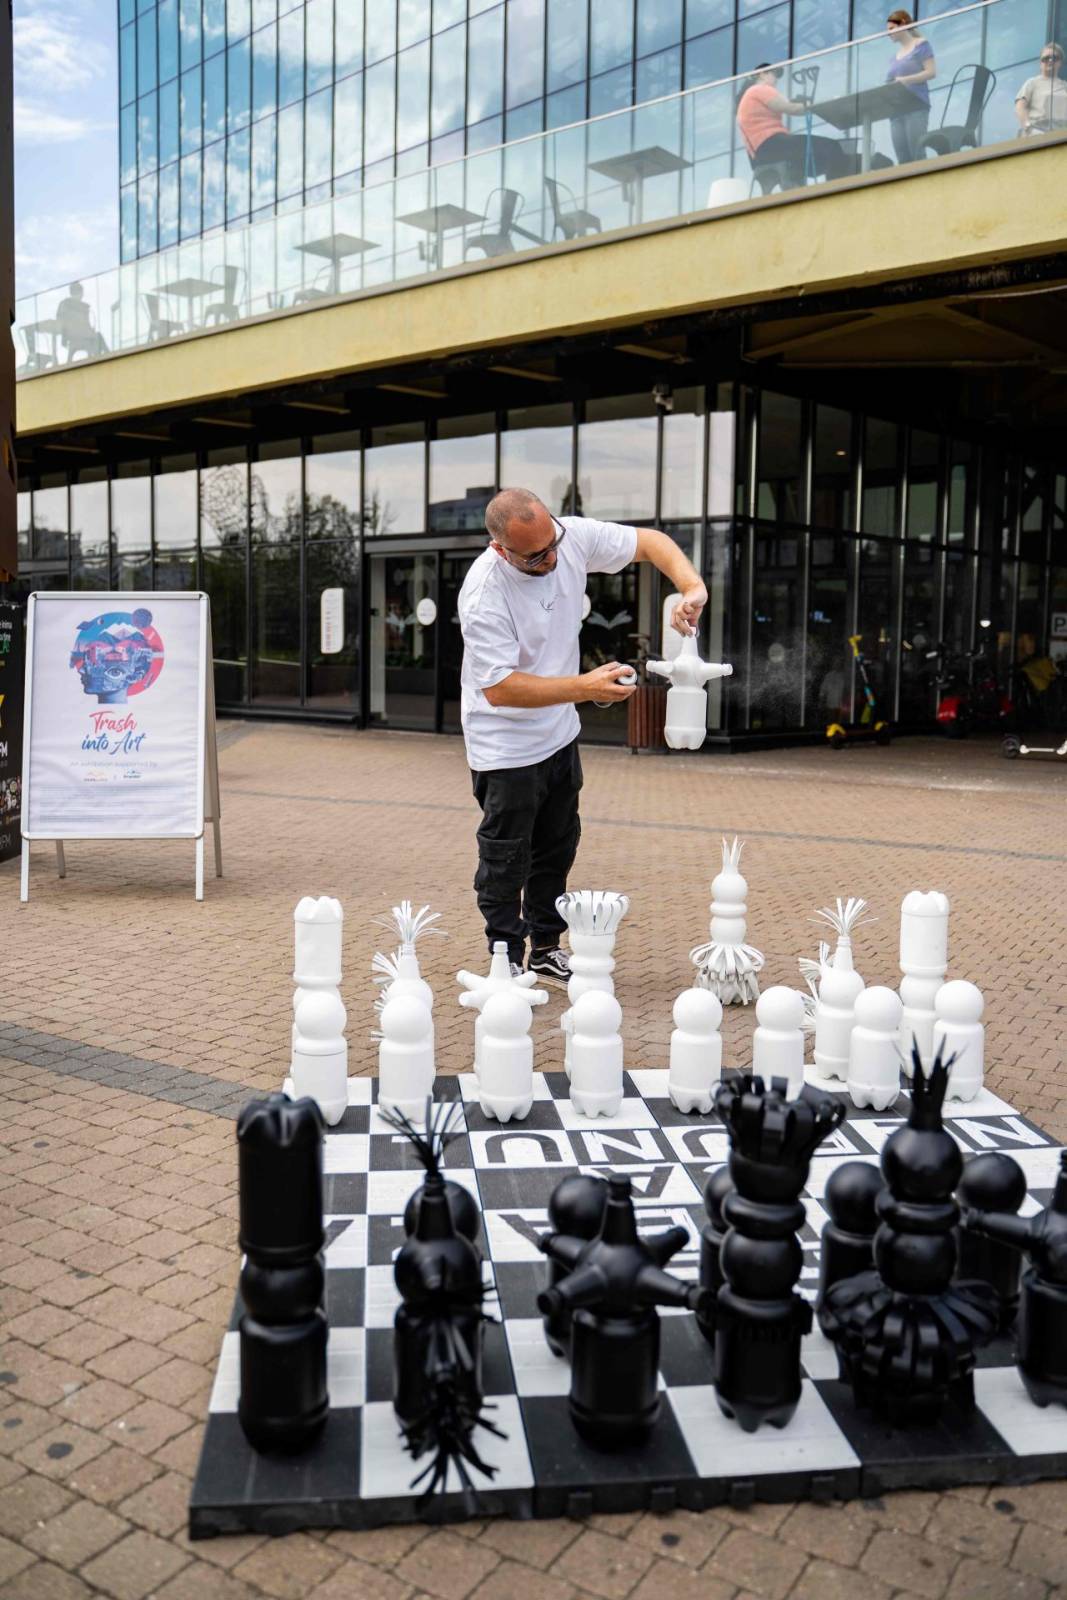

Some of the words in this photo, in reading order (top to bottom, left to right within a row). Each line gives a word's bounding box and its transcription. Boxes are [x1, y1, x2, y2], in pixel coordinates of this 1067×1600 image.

[89, 710, 137, 734] Trash
[81, 733, 109, 752] into
[109, 731, 146, 755] Art
